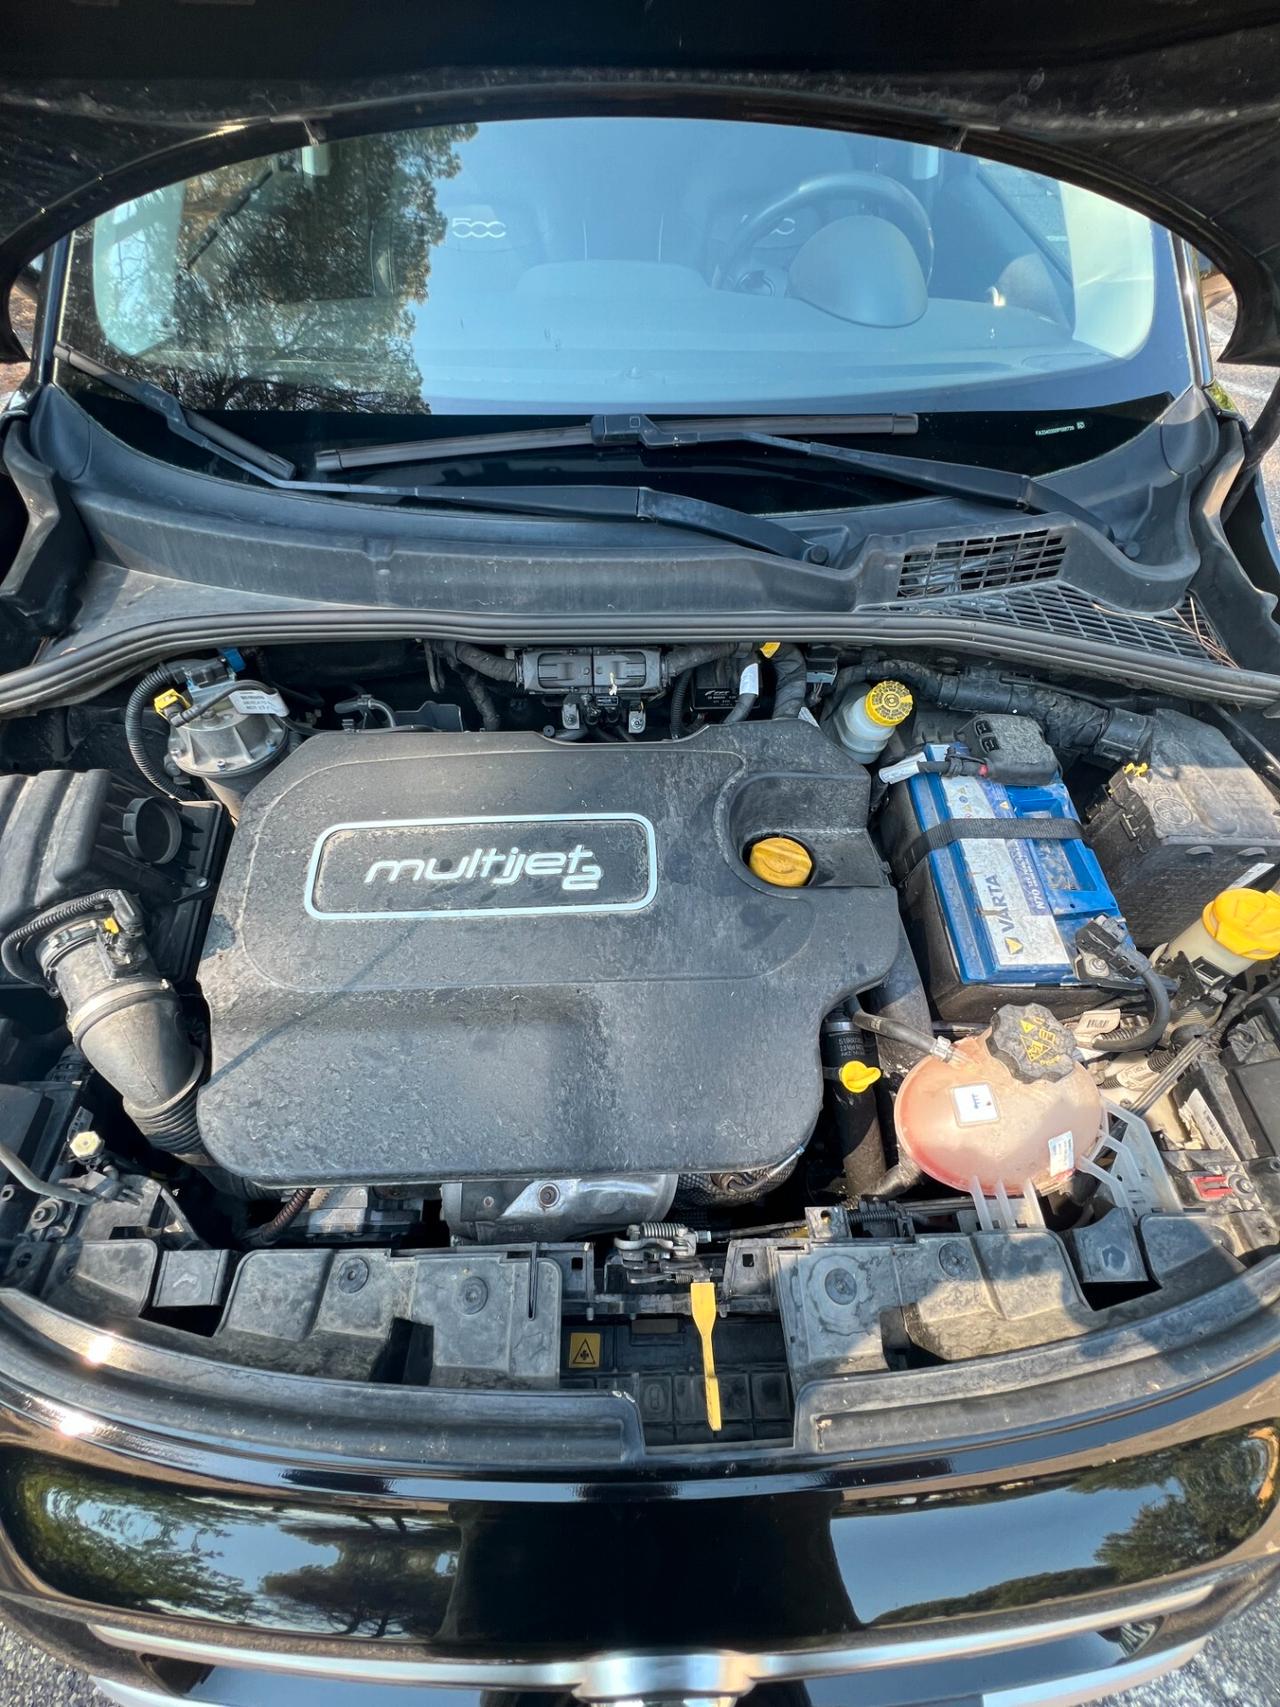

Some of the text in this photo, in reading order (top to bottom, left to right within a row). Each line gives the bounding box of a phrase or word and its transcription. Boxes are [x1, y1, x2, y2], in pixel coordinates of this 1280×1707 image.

[452, 218, 506, 238] 500
[985, 874, 1015, 933] VARTA
[1032, 889, 1046, 909] N70
